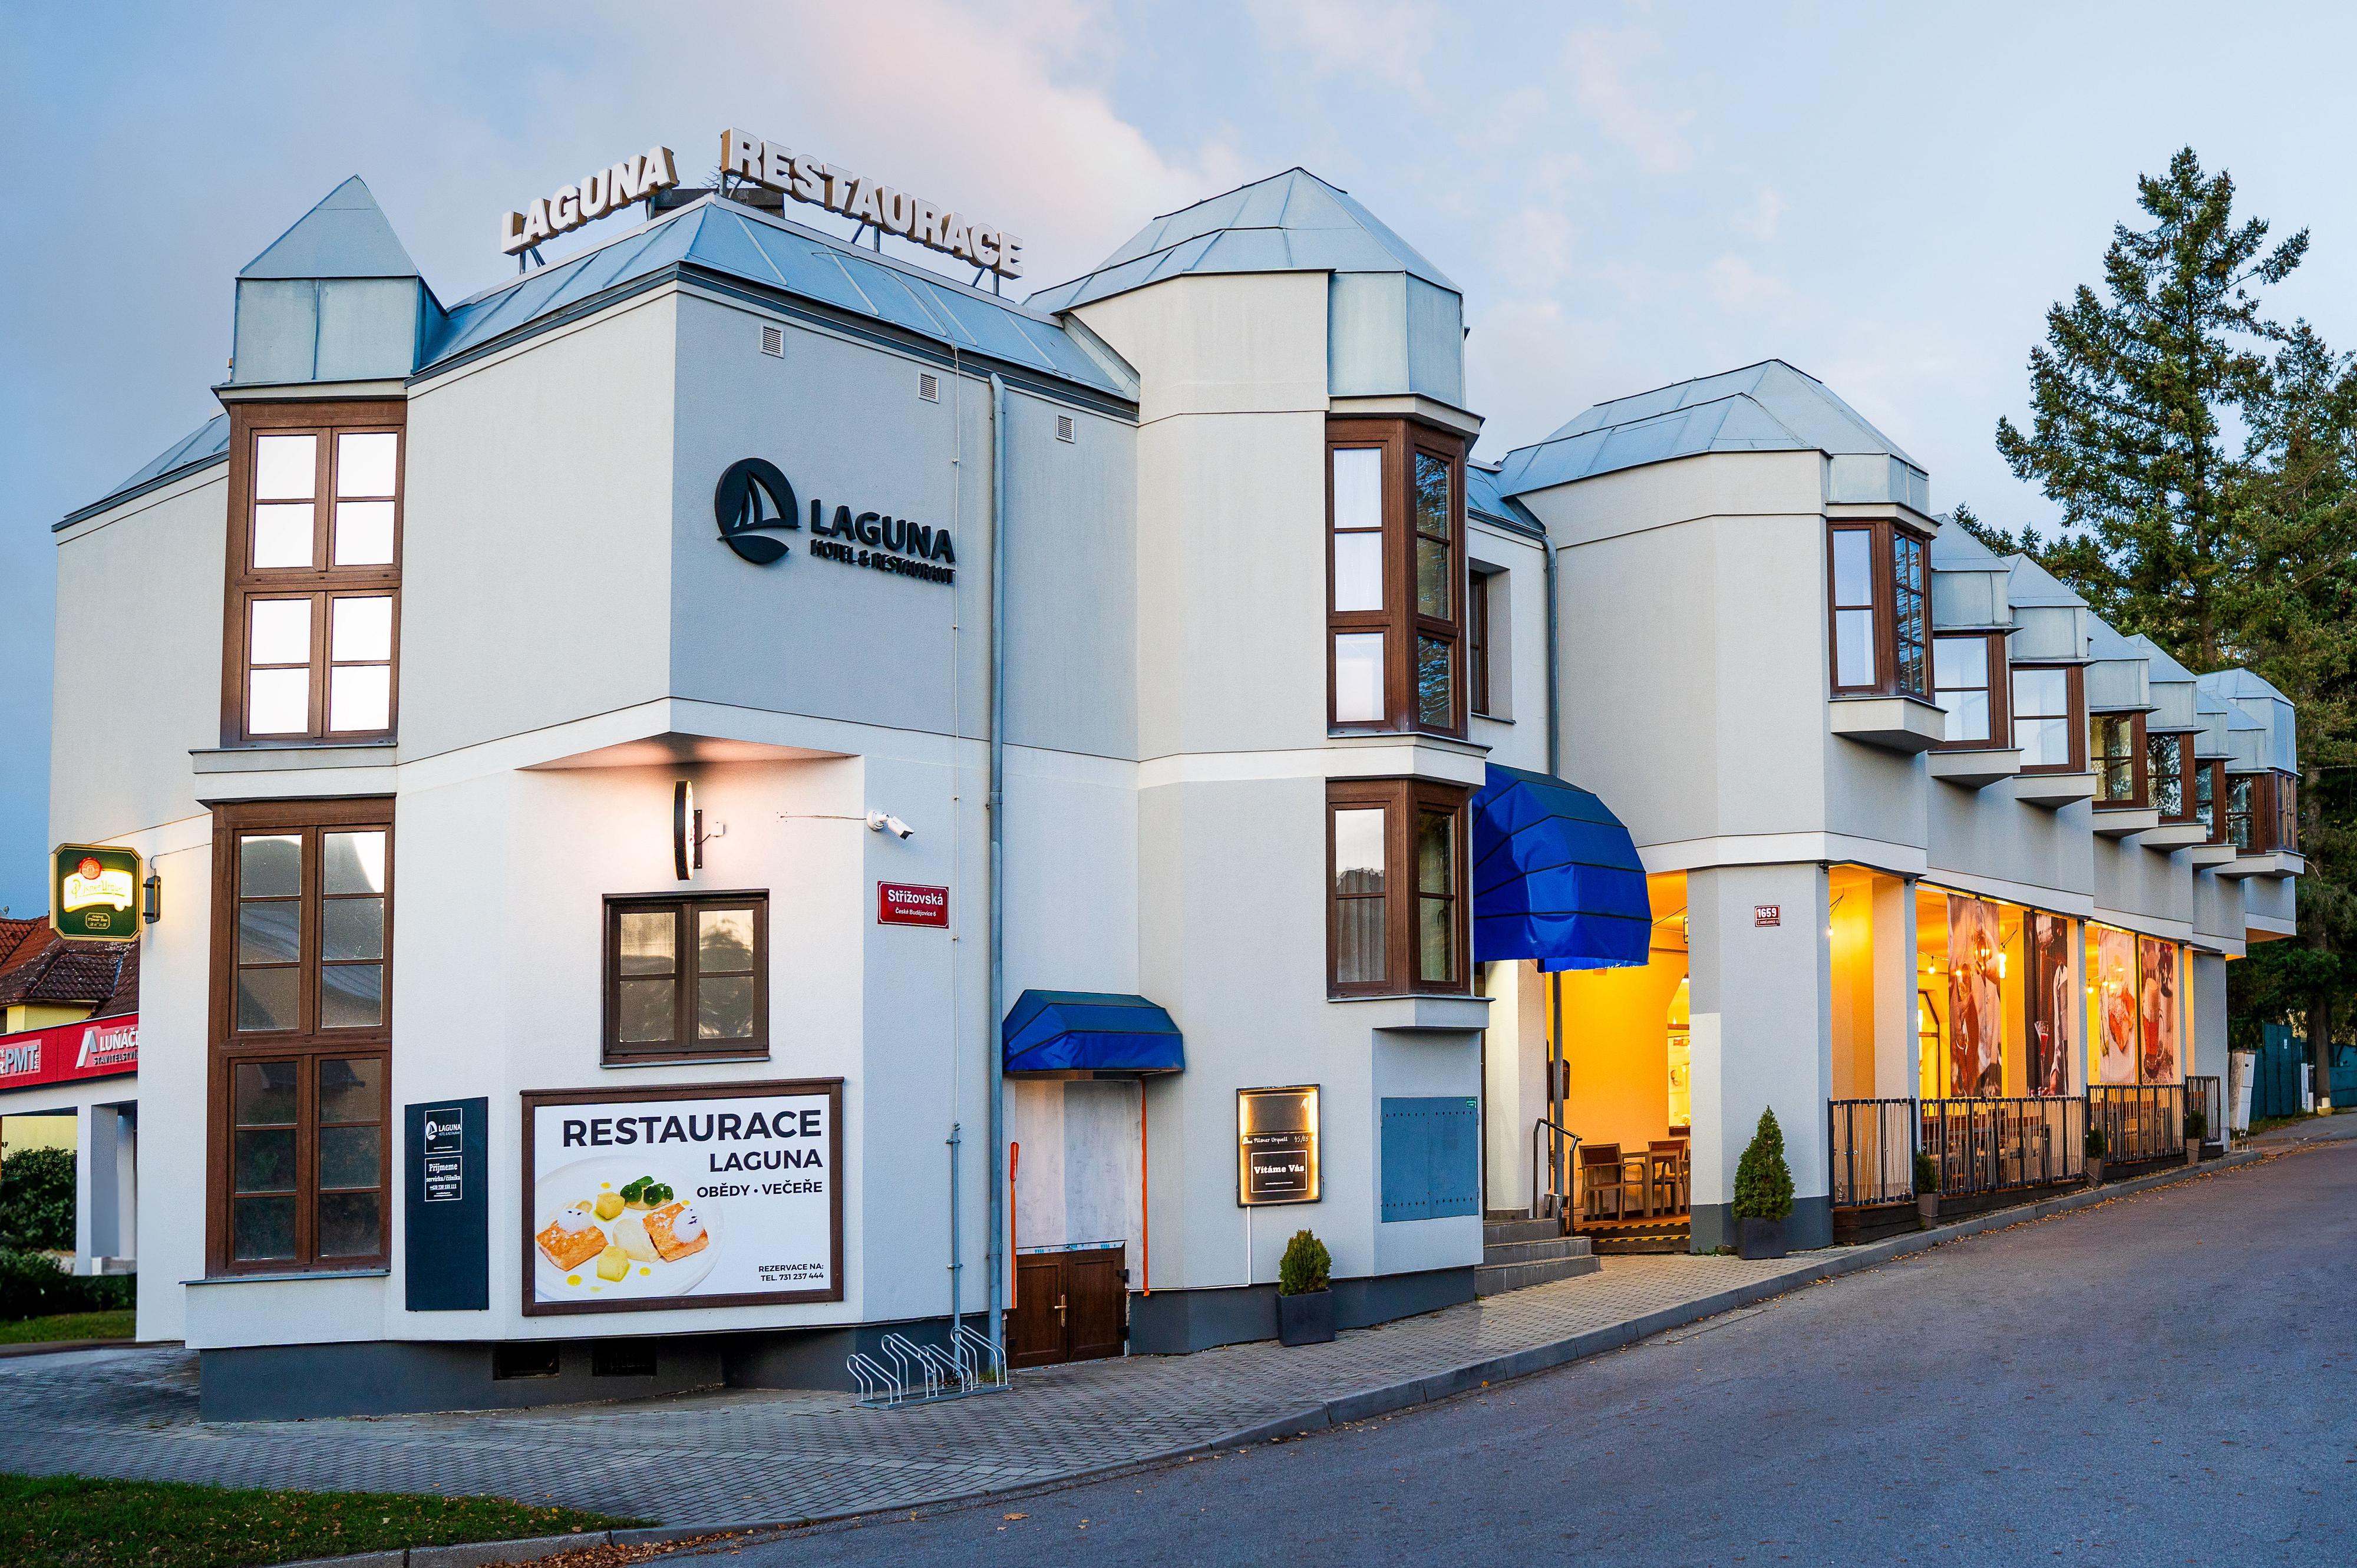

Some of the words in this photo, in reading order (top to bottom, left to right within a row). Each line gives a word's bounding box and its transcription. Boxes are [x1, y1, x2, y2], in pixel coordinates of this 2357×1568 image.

[501, 145, 679, 256] LAGUNA
[721, 127, 1024, 279] RESTAURACE
[810, 499, 956, 563] LAGUNA
[810, 539, 857, 564] HOTEL
[857, 549, 870, 567] &
[871, 552, 956, 584] RESTAURANT
[887, 889, 943, 906] Střížovská
[1757, 907, 1777, 917] 1659
[5, 1045, 38, 1074] PMT
[562, 1109, 823, 1148] RESTAURACE
[1271, 1136, 1288, 1144] Urquell
[709, 1148, 824, 1173] LAGUNA
[1253, 1166, 1286, 1174] Vítáme
[1288, 1164, 1305, 1173] Vás
[696, 1183, 751, 1198] OBĚDY
[764, 1179, 823, 1195] VEČEŘE
[758, 1263, 808, 1272] REZERVACE
